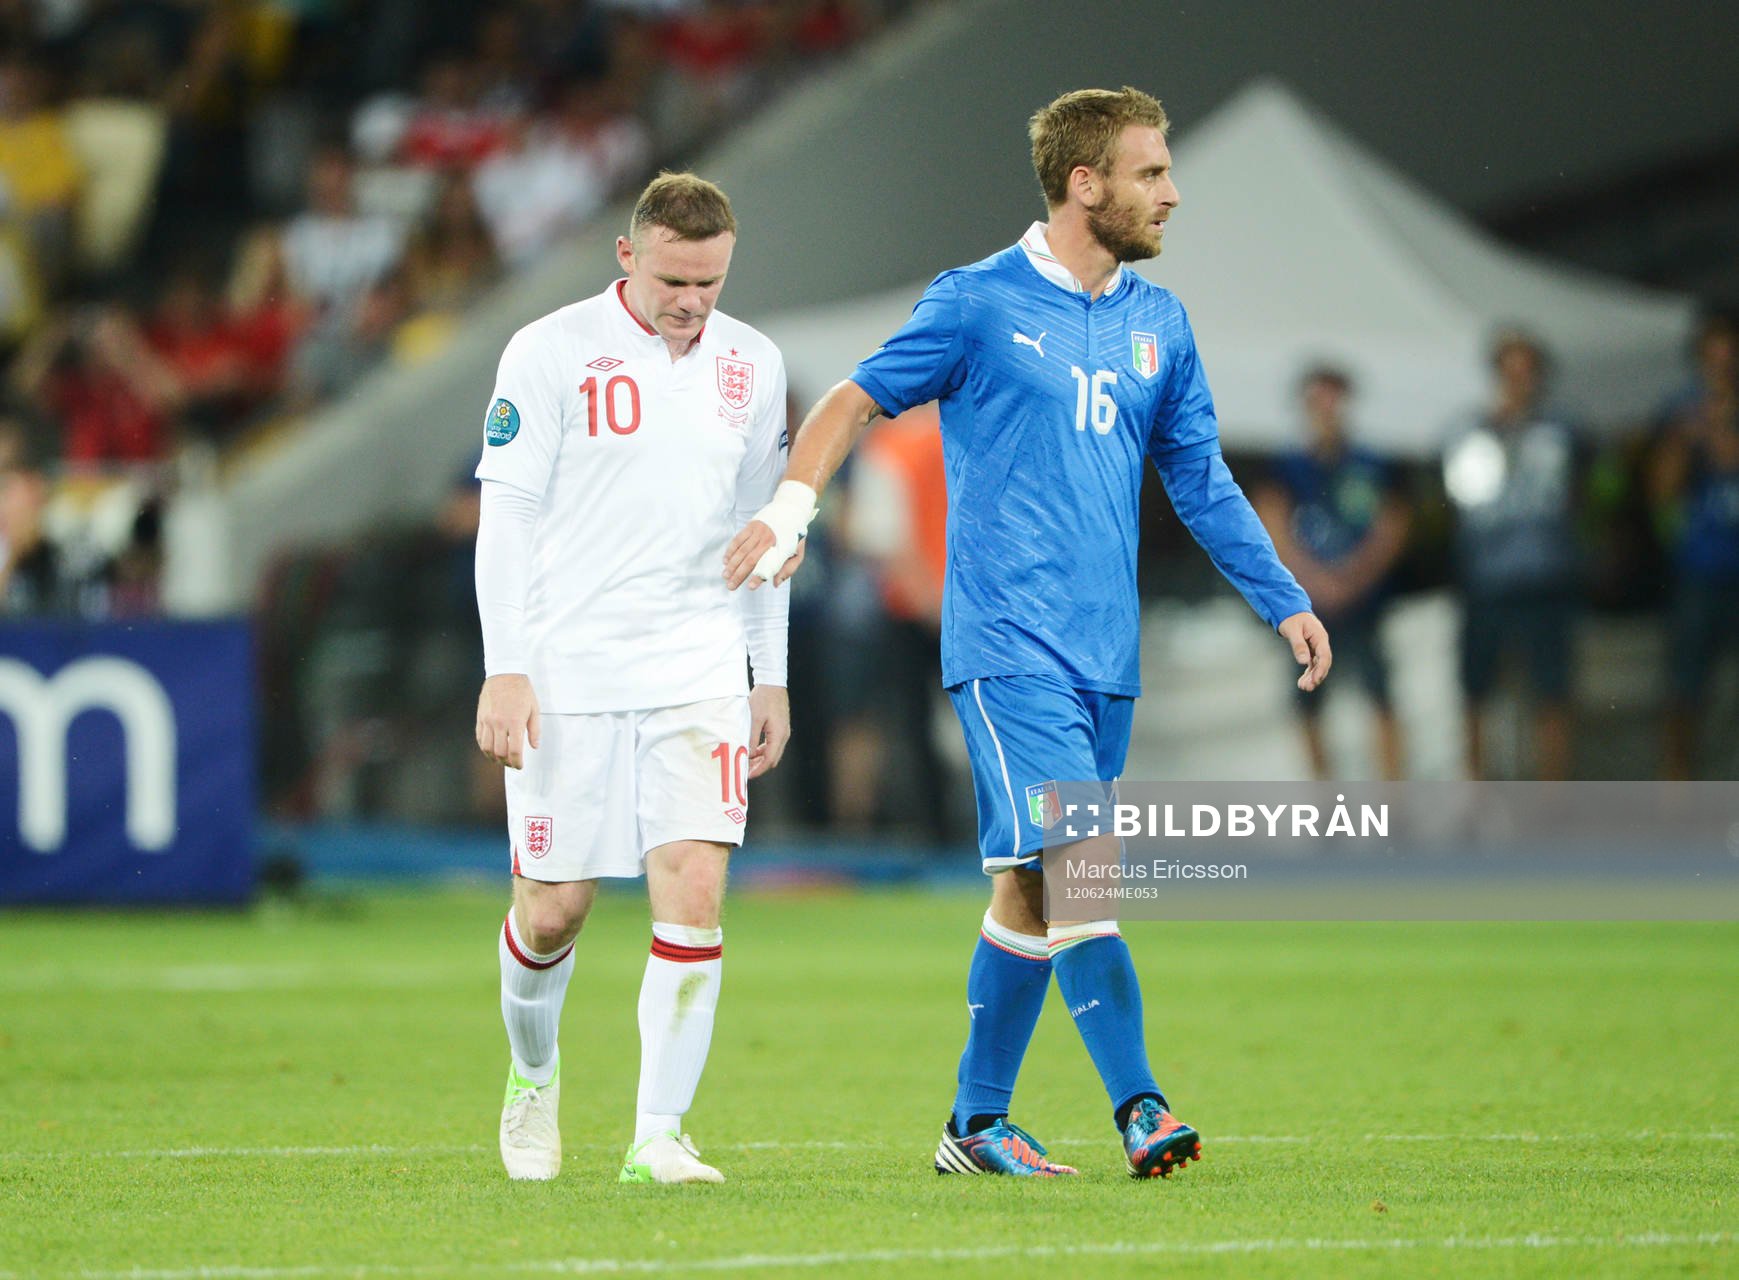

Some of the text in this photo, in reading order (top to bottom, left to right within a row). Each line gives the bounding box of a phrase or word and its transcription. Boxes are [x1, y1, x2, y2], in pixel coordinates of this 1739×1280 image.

[579, 375, 641, 436] 10
[1071, 365, 1119, 435] 16
[711, 742, 748, 806] 10
